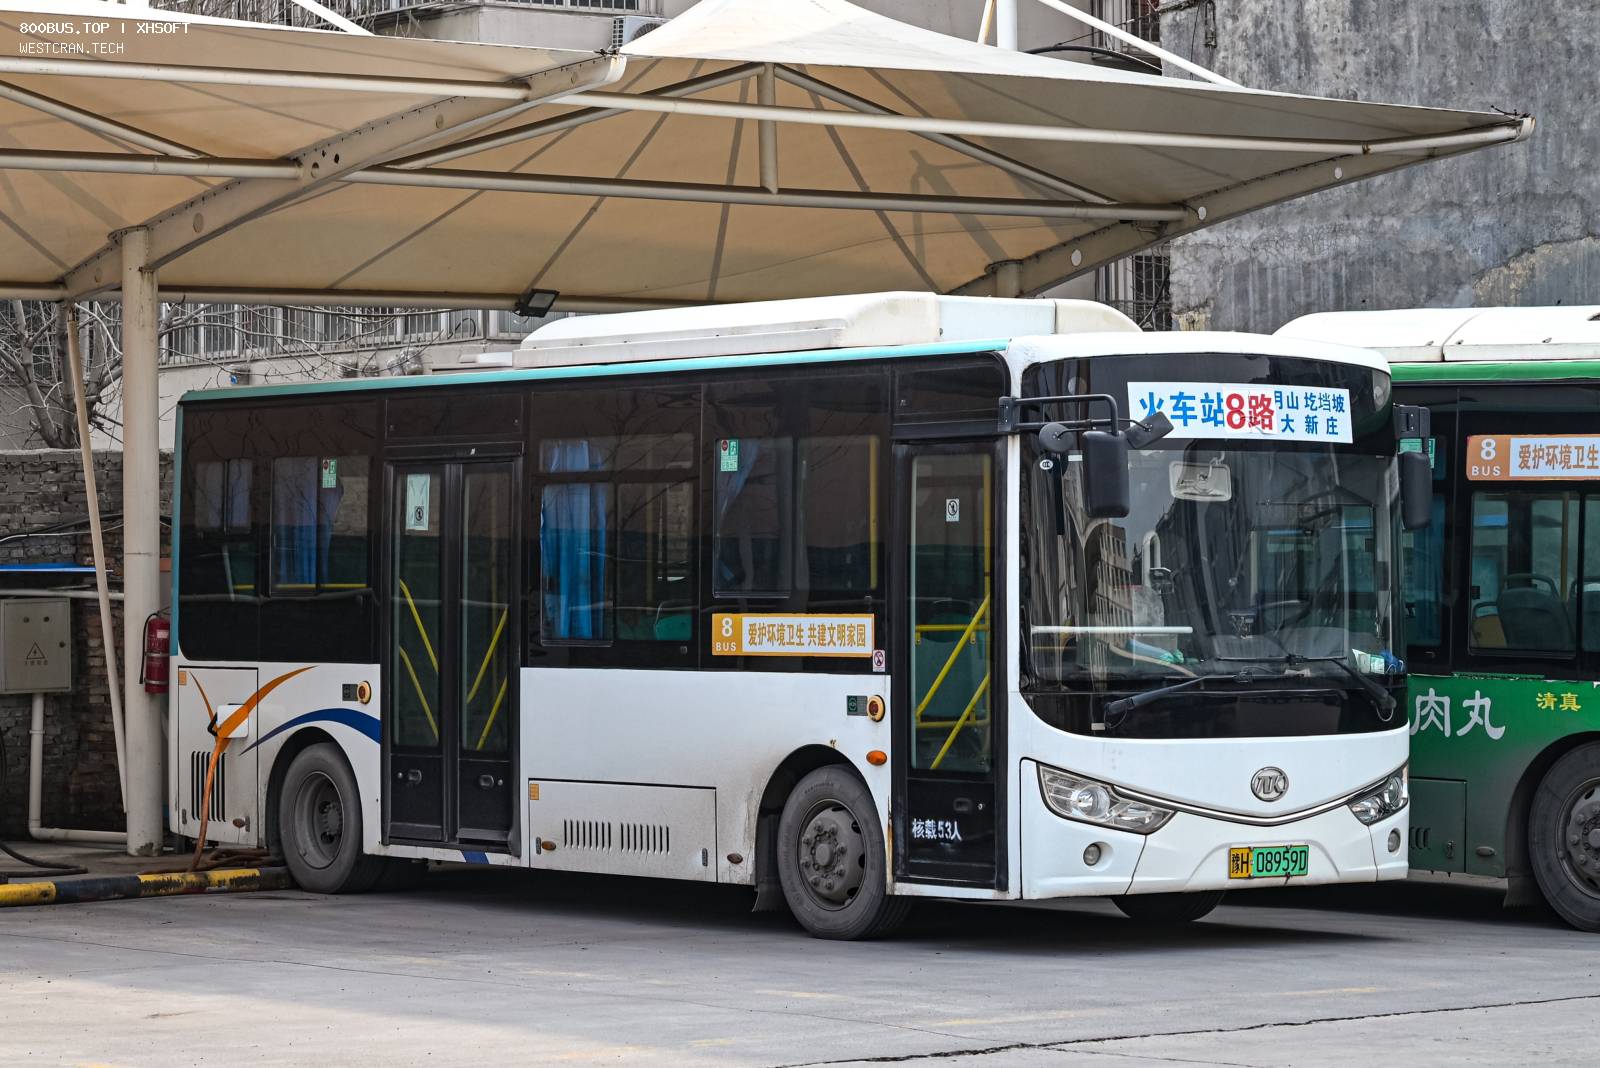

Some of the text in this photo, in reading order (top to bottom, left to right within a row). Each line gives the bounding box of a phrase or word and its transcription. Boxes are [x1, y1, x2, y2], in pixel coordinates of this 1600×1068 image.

[1480, 438, 1497, 460] 8
[1518, 443, 1600, 471] 爱护环境卫生
[1471, 466, 1501, 476] BUS
[721, 617, 734, 637] 8
[748, 622, 866, 648] 爱护环境卫生 共建文明家园
[715, 641, 737, 652] BUS
[1535, 691, 1582, 712] 清真
[911, 818, 962, 841] 核载53人
